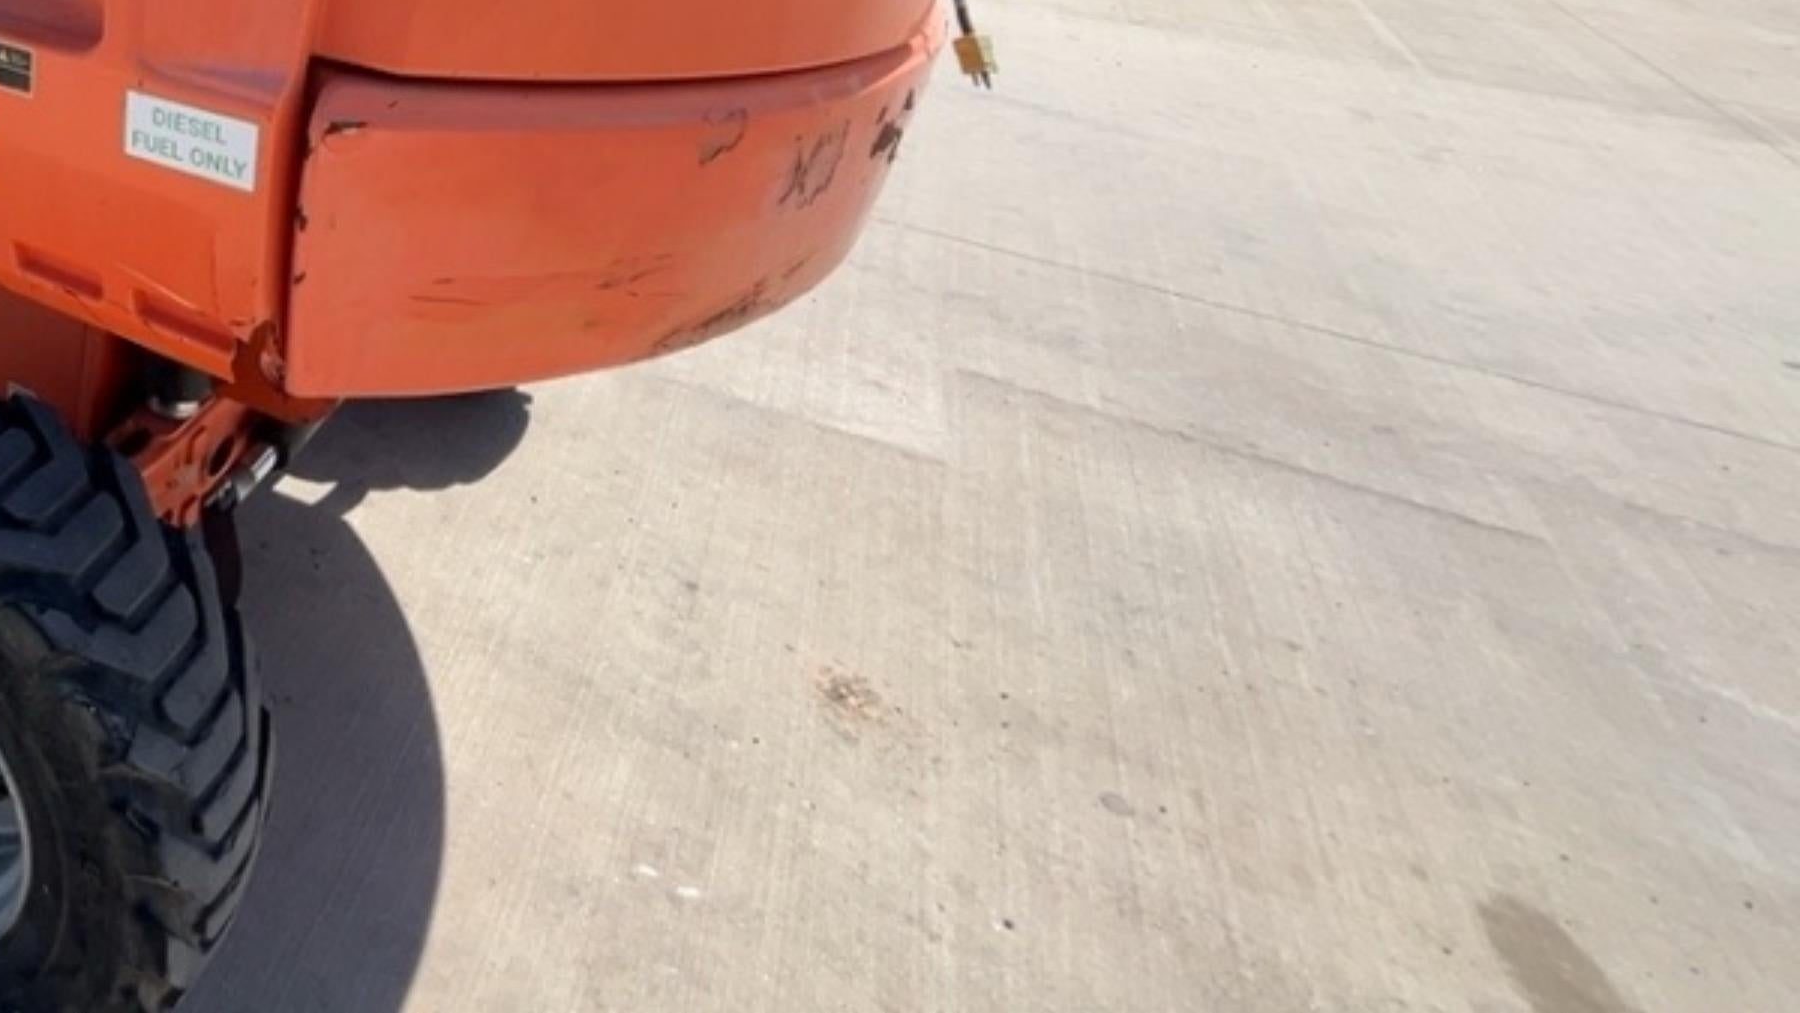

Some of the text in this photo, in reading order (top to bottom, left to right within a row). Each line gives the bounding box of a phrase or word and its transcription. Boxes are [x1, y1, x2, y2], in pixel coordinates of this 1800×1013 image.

[152, 106, 228, 146] DIESEL
[131, 130, 248, 181] FUEL ONLY
